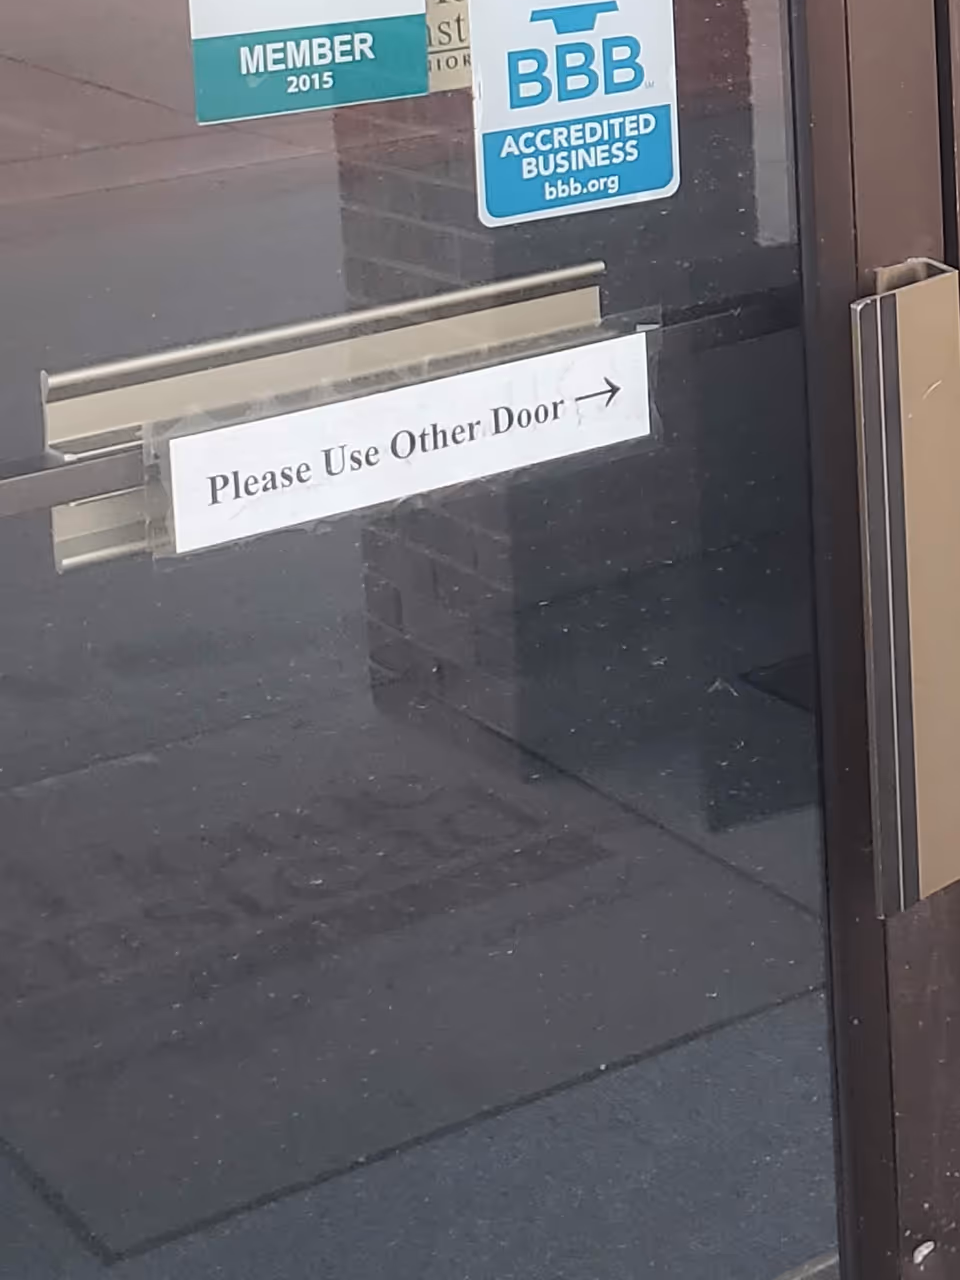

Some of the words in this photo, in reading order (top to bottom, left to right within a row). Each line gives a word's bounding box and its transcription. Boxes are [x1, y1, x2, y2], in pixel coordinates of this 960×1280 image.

[239, 32, 376, 76] MEMBER
[507, 35, 645, 110] BBB
[286, 71, 335, 95] 2015
[500, 113, 656, 158] ACCREDITED
[521, 139, 639, 180] BUSINESS
[544, 174, 619, 200] bbb.org
[207, 460, 311, 506] Please
[321, 444, 379, 477] Use
[390, 419, 481, 461] Other
[490, 394, 564, 434] Door
